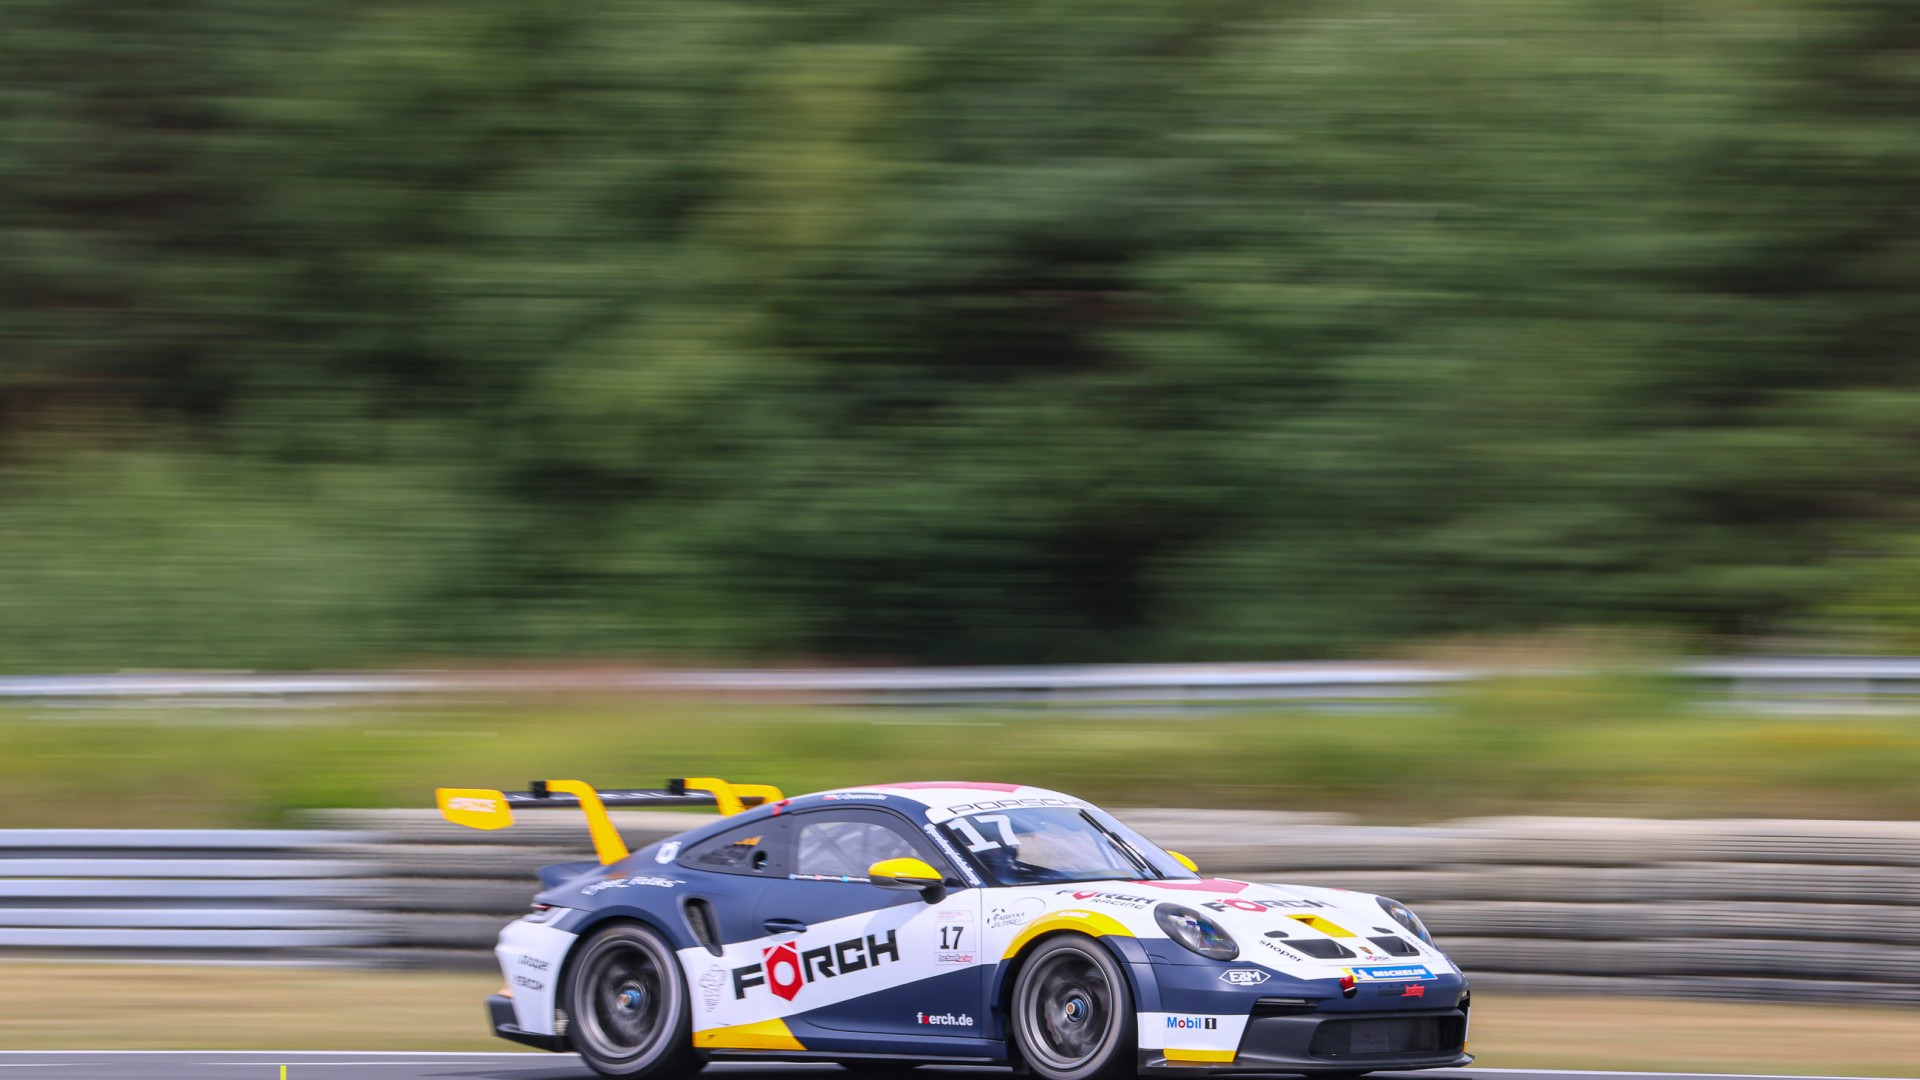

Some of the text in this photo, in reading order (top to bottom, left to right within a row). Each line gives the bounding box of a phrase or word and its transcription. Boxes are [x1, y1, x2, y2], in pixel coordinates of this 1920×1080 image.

[946, 814, 1022, 853] 17
[940, 926, 964, 950] 17
[1259, 940, 1304, 962] shoper
[1372, 968, 1428, 978] MICHELIN
[917, 1012, 974, 1026] foerch.de
[1167, 1016, 1217, 1029] Mobil 1
